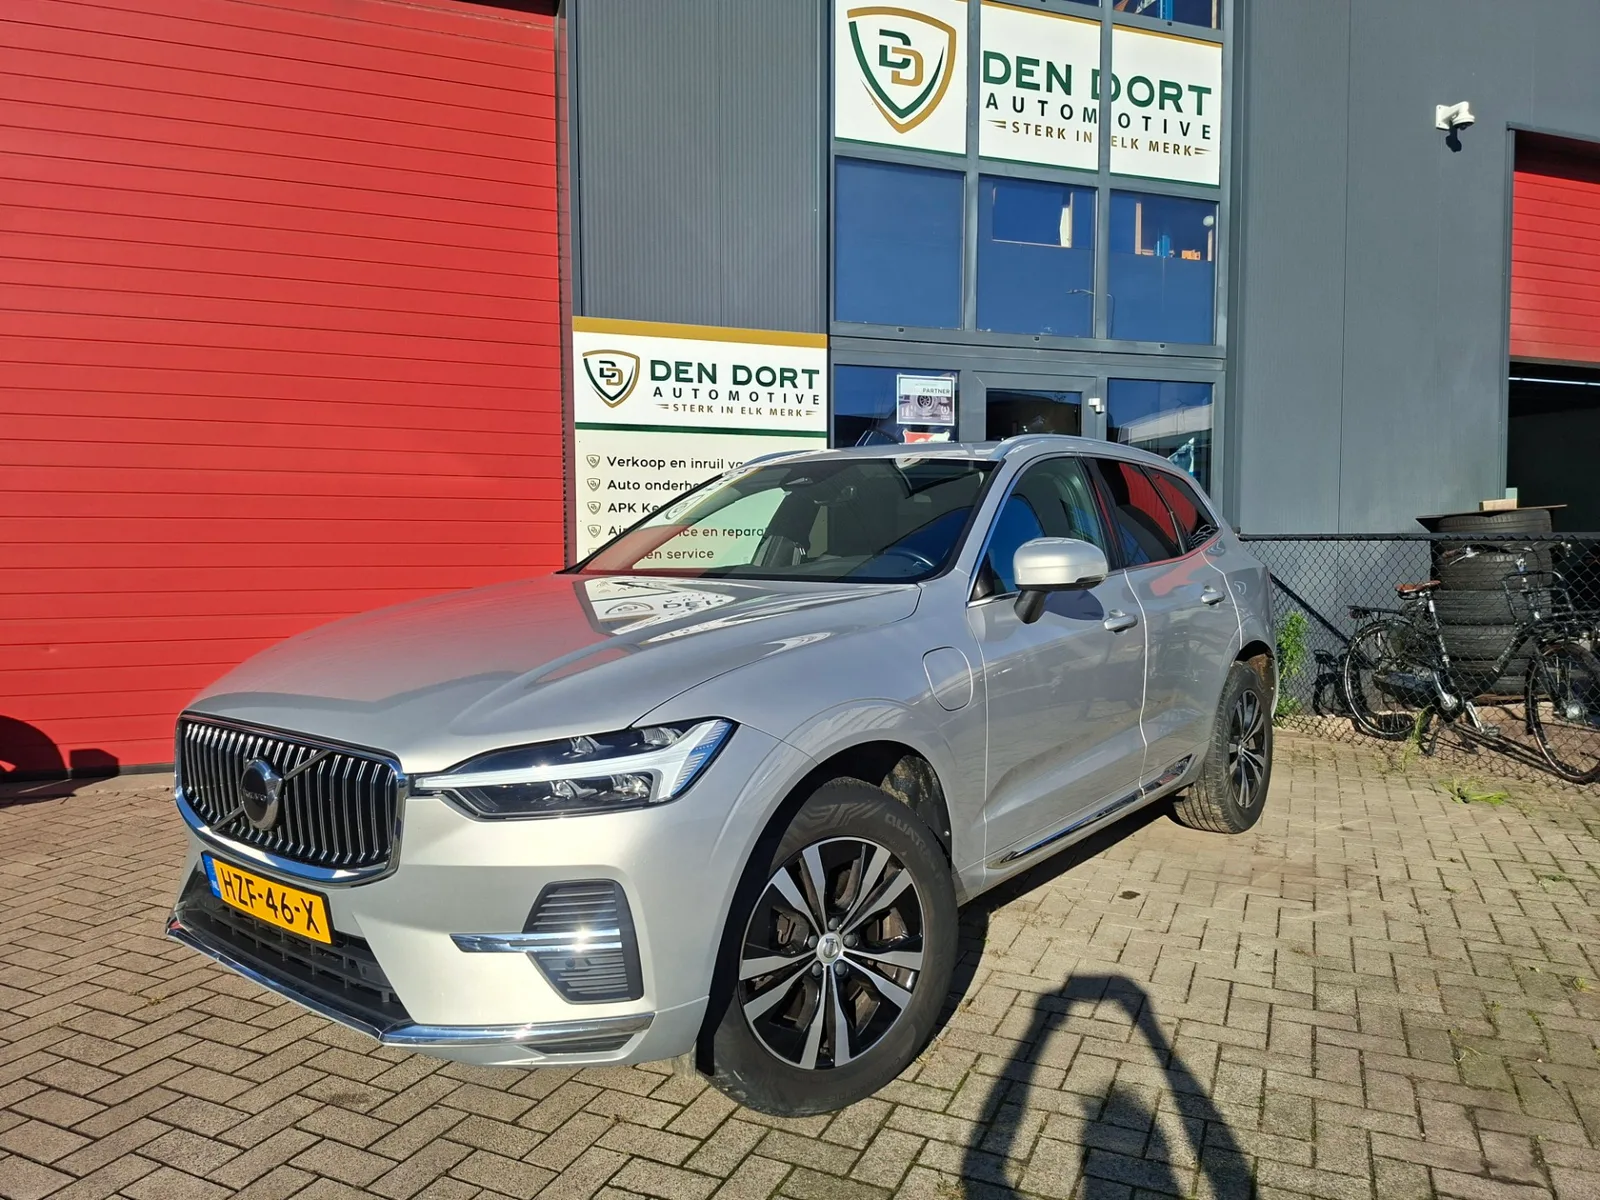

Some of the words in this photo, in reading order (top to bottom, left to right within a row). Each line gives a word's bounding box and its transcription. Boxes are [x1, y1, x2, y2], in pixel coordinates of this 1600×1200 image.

[983, 50, 1072, 96] DEN
[1091, 68, 1211, 116] DORT
[985, 92, 1211, 140] AUTOMOTIVE
[1012, 121, 1066, 140] STERK
[1076, 130, 1092, 143] IN
[1111, 135, 1139, 150] ELK
[1149, 140, 1192, 156] MERK
[650, 360, 717, 384] DEN
[732, 365, 820, 390] DORT
[653, 387, 820, 405] AUTOMOTIVE
[673, 403, 713, 413] STERK
[721, 405, 733, 414] IN
[741, 406, 762, 415] ELK
[769, 408, 802, 417] MERK
[607, 456, 666, 471] Verkoop
[670, 459, 686, 469] en
[691, 458, 724, 470] inruil
[728, 460, 743, 469] va
[607, 480, 641, 491] Auto
[645, 480, 700, 491] onderh
[608, 502, 637, 513] APK
[642, 502, 662, 513] Ke
[702, 527, 718, 537] en
[723, 526, 766, 539] repara
[667, 548, 714, 559] service
[220, 867, 320, 934] HZF-46-X
